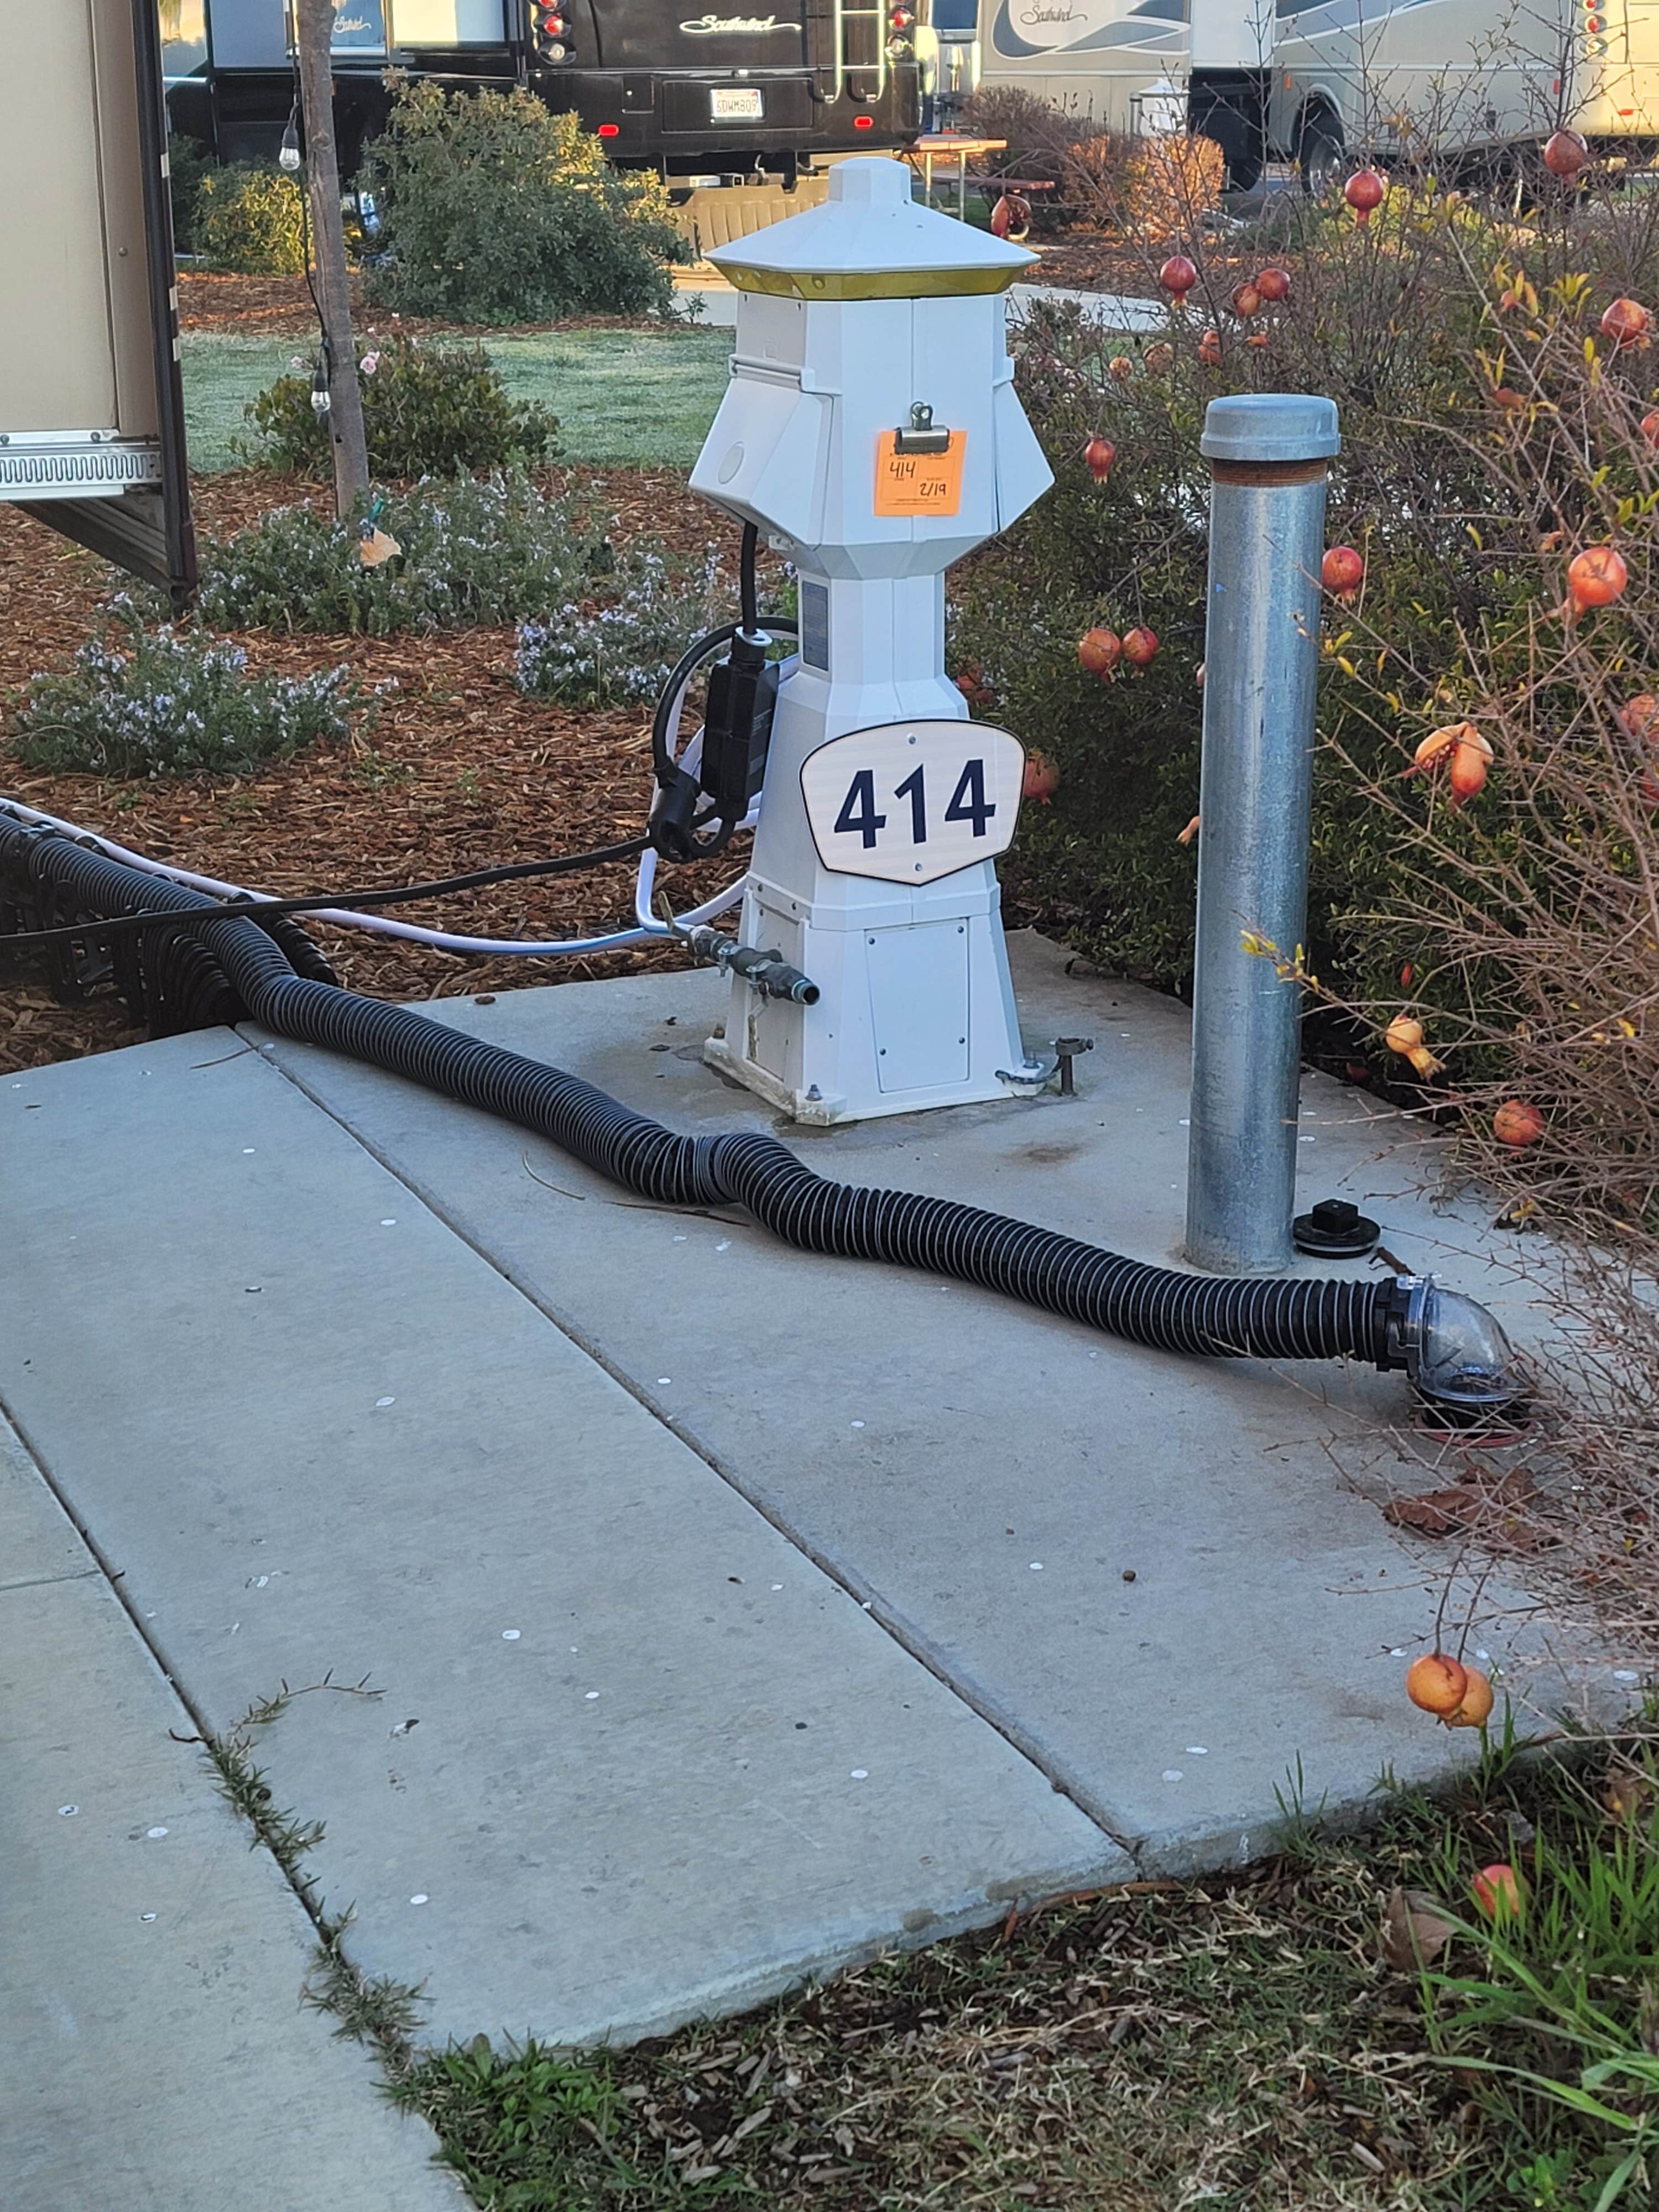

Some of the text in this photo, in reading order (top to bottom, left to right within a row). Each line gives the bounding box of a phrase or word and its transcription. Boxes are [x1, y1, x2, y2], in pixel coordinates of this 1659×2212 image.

[889, 461, 916, 478] 414
[919, 482, 947, 497] 2/19
[834, 759, 996, 849] 414
